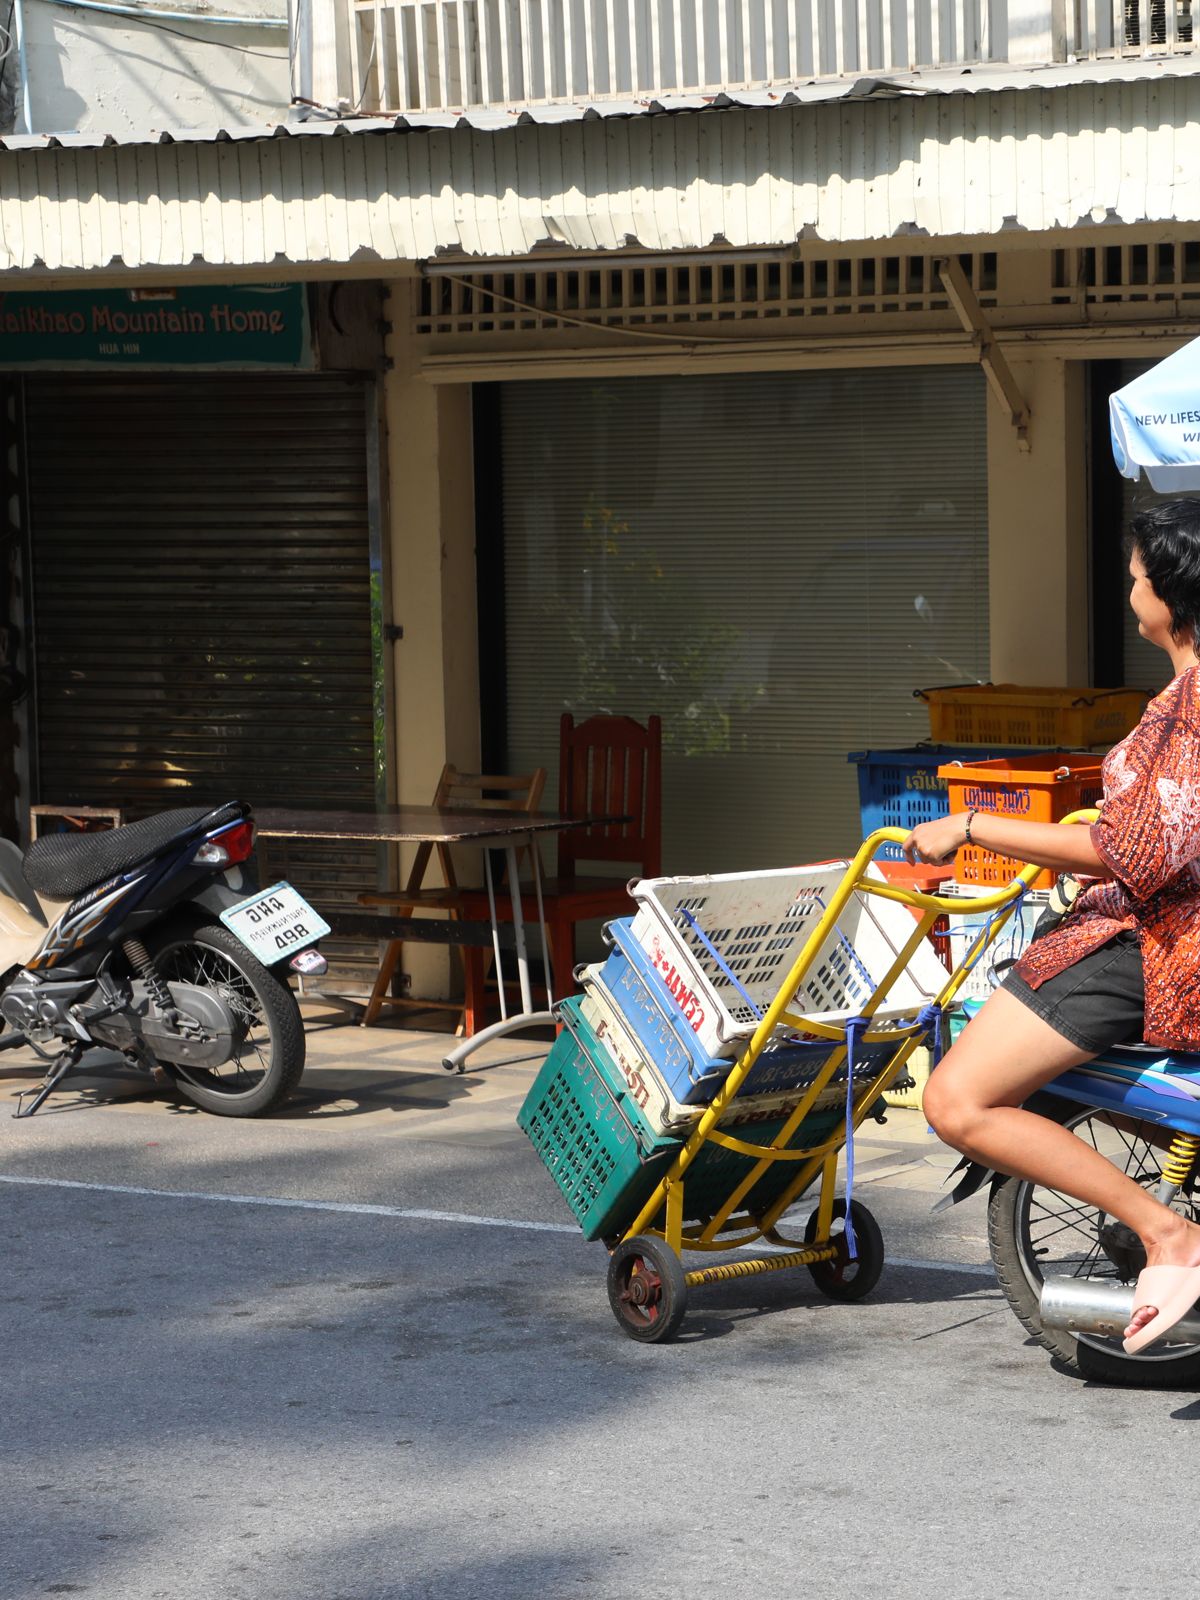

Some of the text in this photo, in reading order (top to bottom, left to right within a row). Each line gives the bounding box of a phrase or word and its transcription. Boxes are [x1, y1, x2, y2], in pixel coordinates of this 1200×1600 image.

[92, 305, 204, 333] Mountain
[211, 303, 284, 334] Home
[99, 343, 140, 354] HUA HIN
[1135, 413, 1168, 427] NEW
[274, 923, 310, 949] 498
